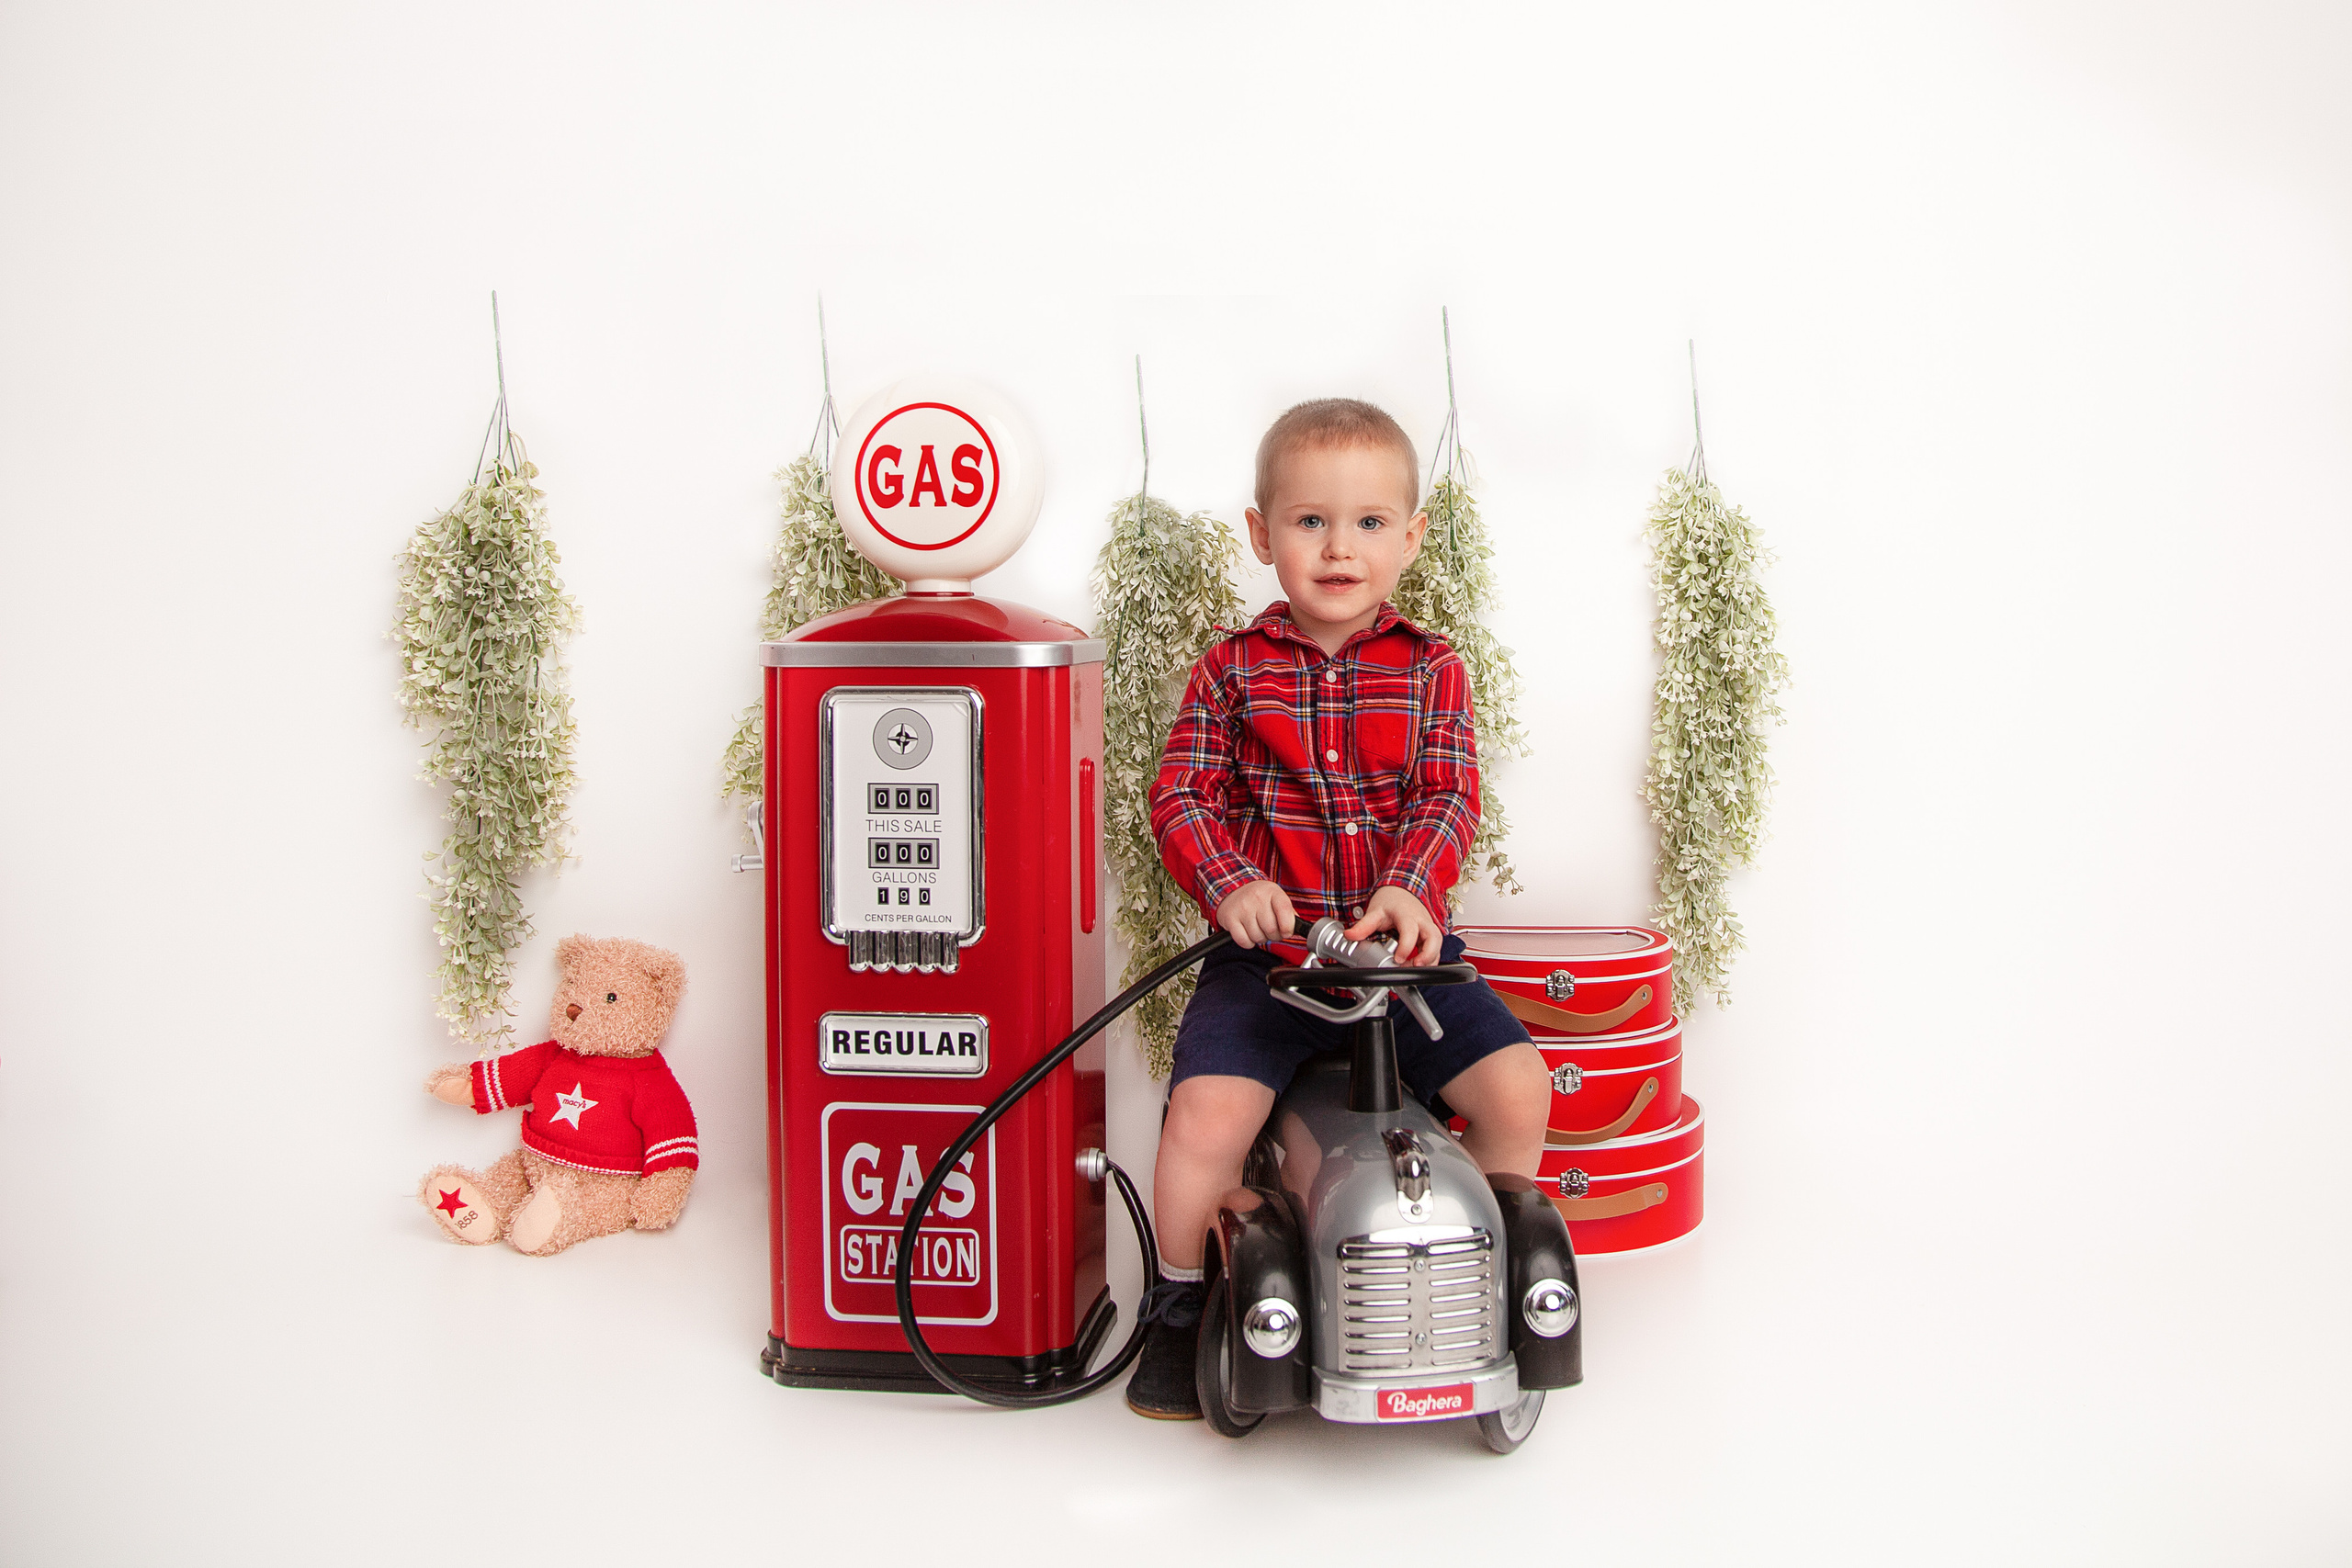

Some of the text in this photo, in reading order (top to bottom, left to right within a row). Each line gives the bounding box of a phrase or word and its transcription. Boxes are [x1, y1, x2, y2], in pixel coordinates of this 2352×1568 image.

[867, 443, 985, 509] GAS
[865, 819, 943, 833] THIS SALE
[872, 871, 937, 884] GALLONS
[865, 913, 952, 923] CENTS PER GALLON
[832, 1030, 978, 1057] REGULAR
[842, 1142, 976, 1219] GAS
[454, 1210, 479, 1230] 1858
[847, 1233, 976, 1278] STAION
[1387, 1391, 1462, 1416] Baghera
